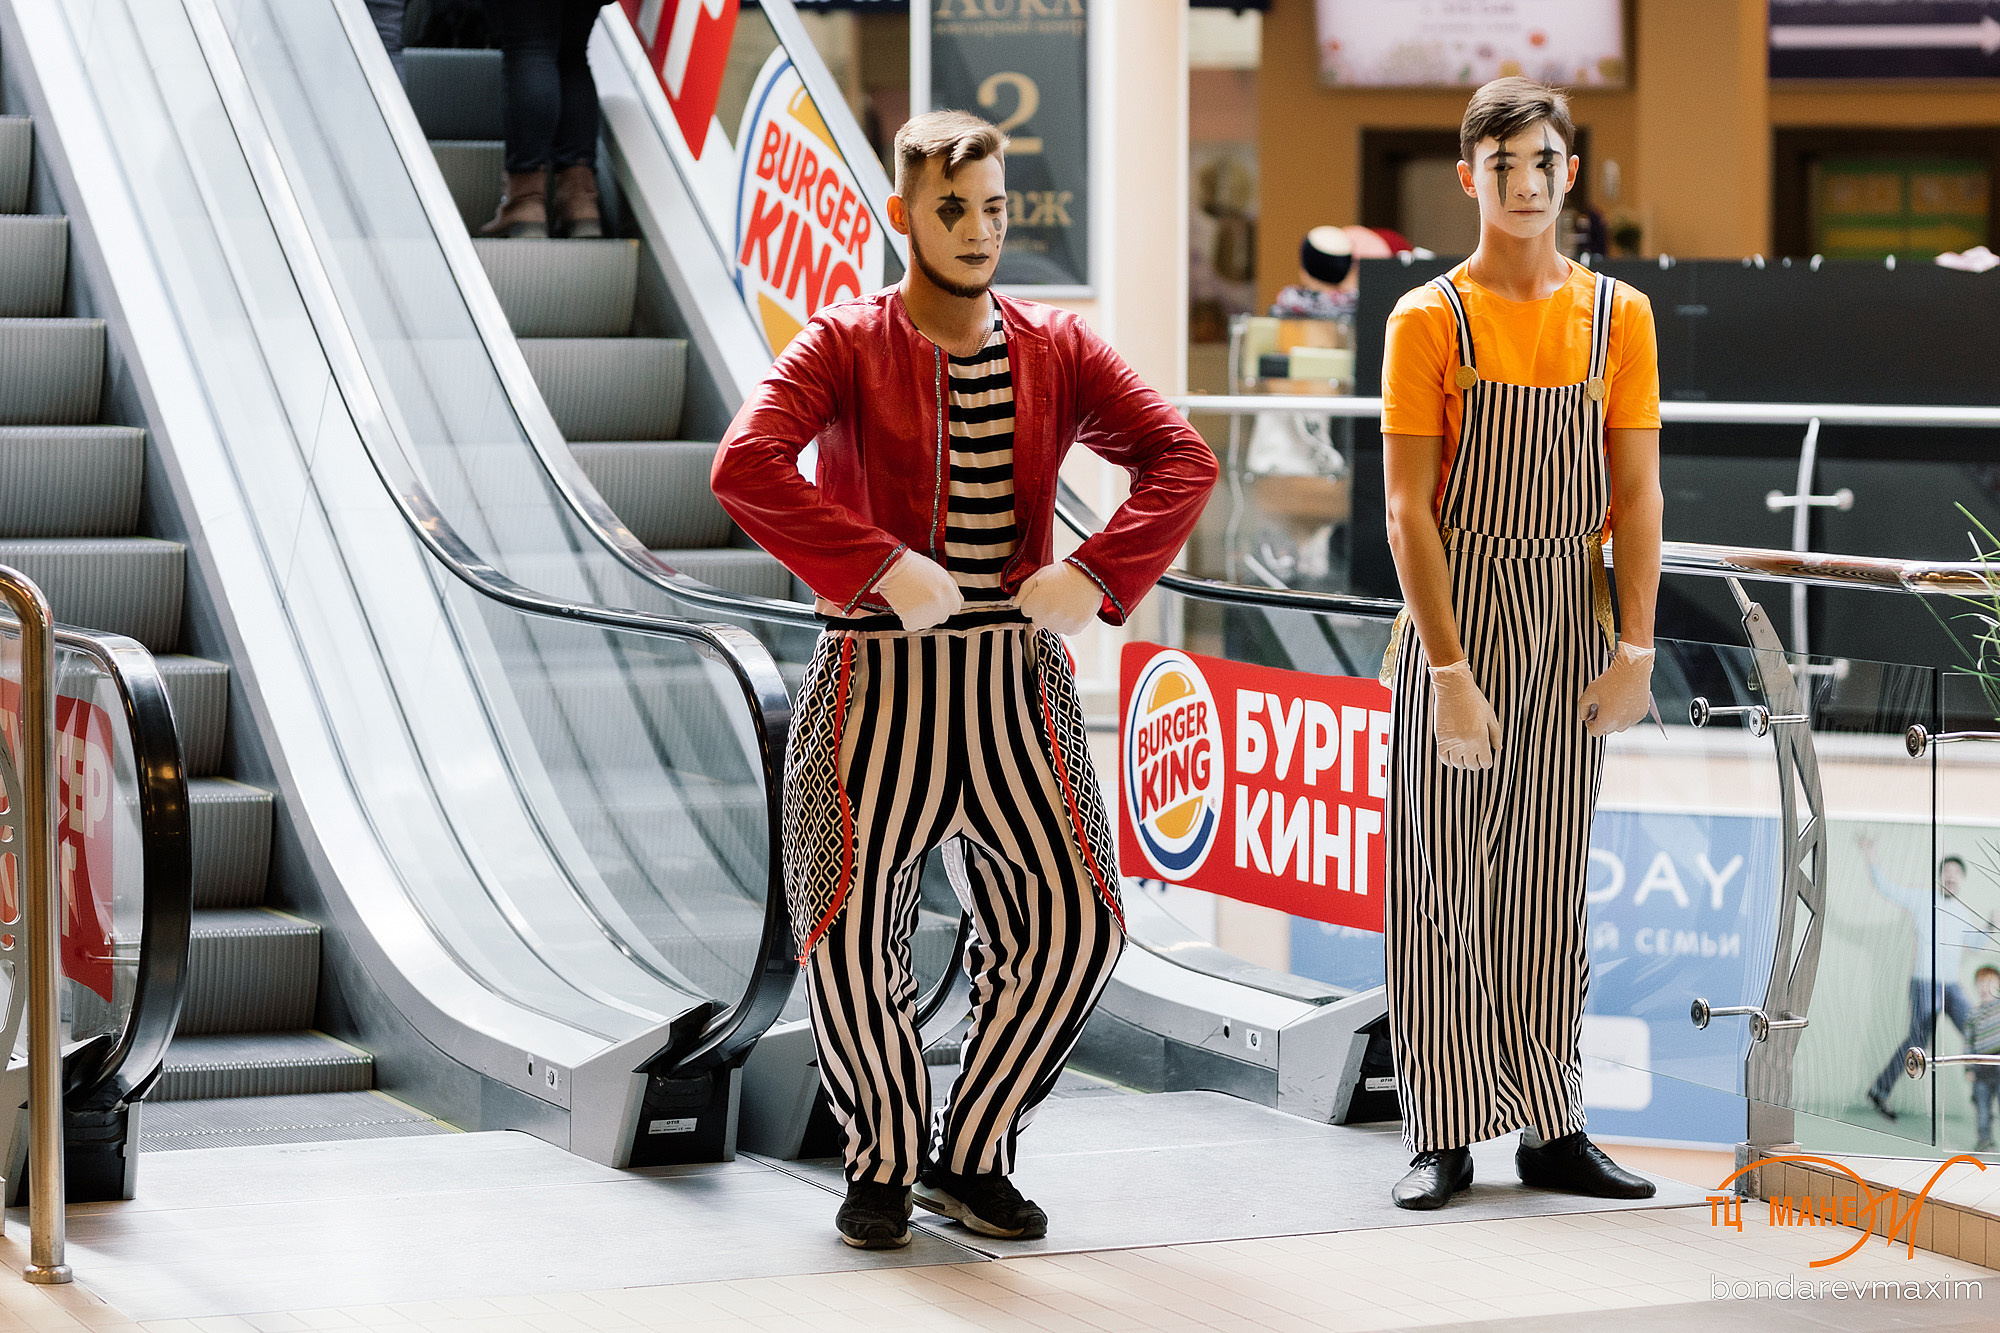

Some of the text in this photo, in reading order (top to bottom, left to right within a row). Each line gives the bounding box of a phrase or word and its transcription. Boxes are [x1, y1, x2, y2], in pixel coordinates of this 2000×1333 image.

[976, 71, 1044, 154] 2
[756, 119, 871, 271] BURGER
[1138, 700, 1208, 768] BURGER
[1140, 737, 1212, 826] KING
[1235, 688, 1391, 799] БУРГЕ
[1234, 783, 1382, 896] КИНГ
